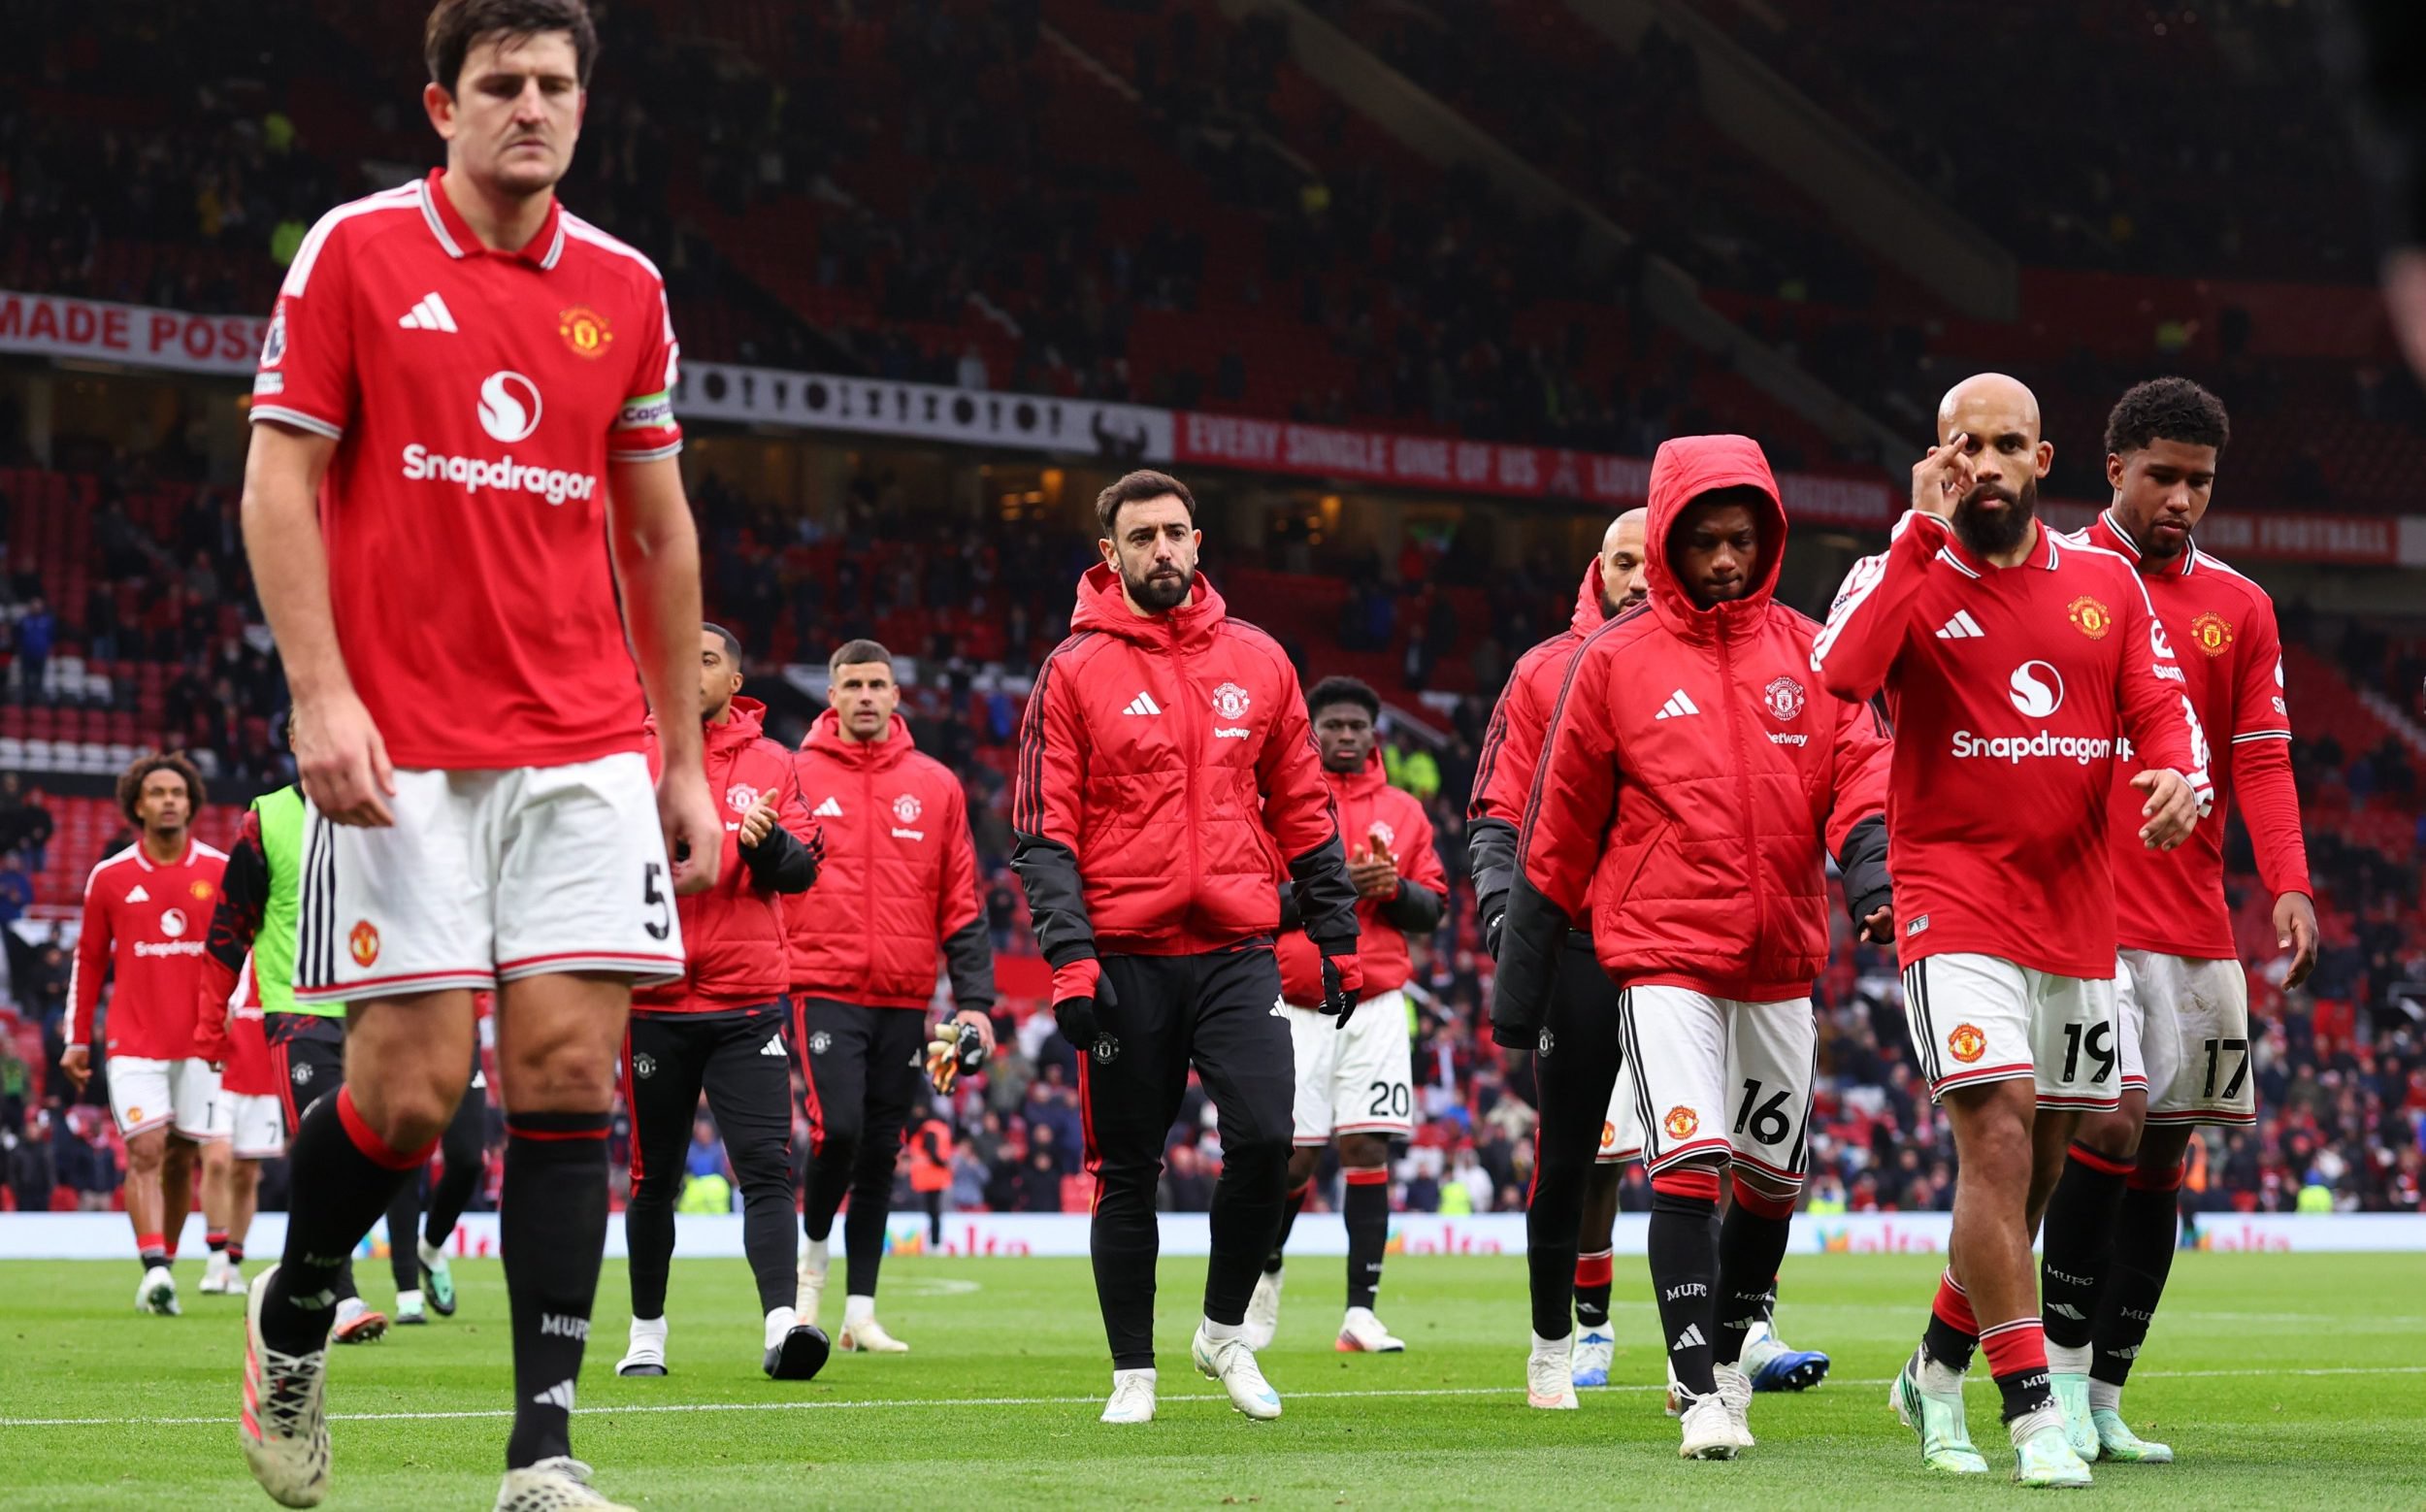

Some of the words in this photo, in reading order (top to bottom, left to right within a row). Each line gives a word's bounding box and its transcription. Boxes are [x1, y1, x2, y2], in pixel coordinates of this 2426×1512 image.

[1186, 413, 1278, 461] EVERY
[1286, 424, 1385, 477] SINGLE
[1394, 436, 1449, 481] ONE
[1456, 441, 1489, 484] OF
[1496, 444, 1537, 489] US
[1951, 729, 2111, 766] Snapdragon
[644, 862, 671, 940] 5
[2062, 1020, 2115, 1084] 19
[2203, 1038, 2248, 1099] 17
[1370, 1081, 1409, 1117] 20
[1733, 1077, 1791, 1146] 16
[267, 1121, 278, 1143] 7
[1666, 1283, 1707, 1301] MUFC
[2048, 1264, 2094, 1286] MUFC
